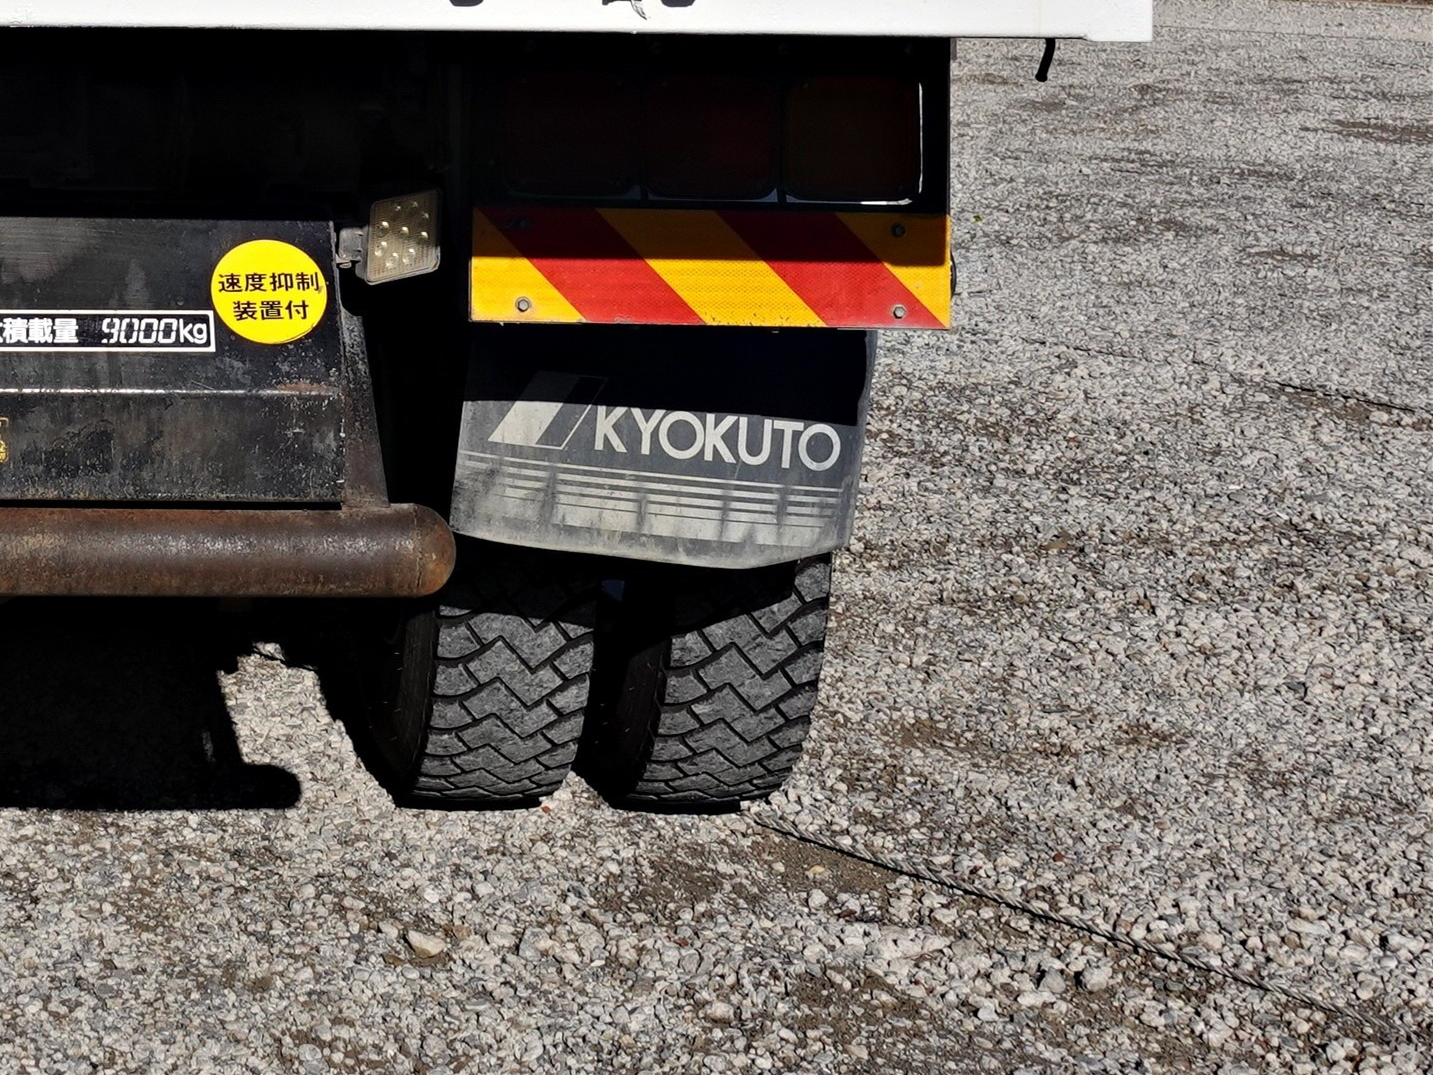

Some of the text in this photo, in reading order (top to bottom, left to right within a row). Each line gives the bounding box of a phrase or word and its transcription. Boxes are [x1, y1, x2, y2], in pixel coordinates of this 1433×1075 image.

[217, 271, 321, 293] 速度抑制
[232, 299, 310, 322] 装置付
[101, 317, 208, 344] 9000kg
[594, 404, 842, 472] KYOKUTO
